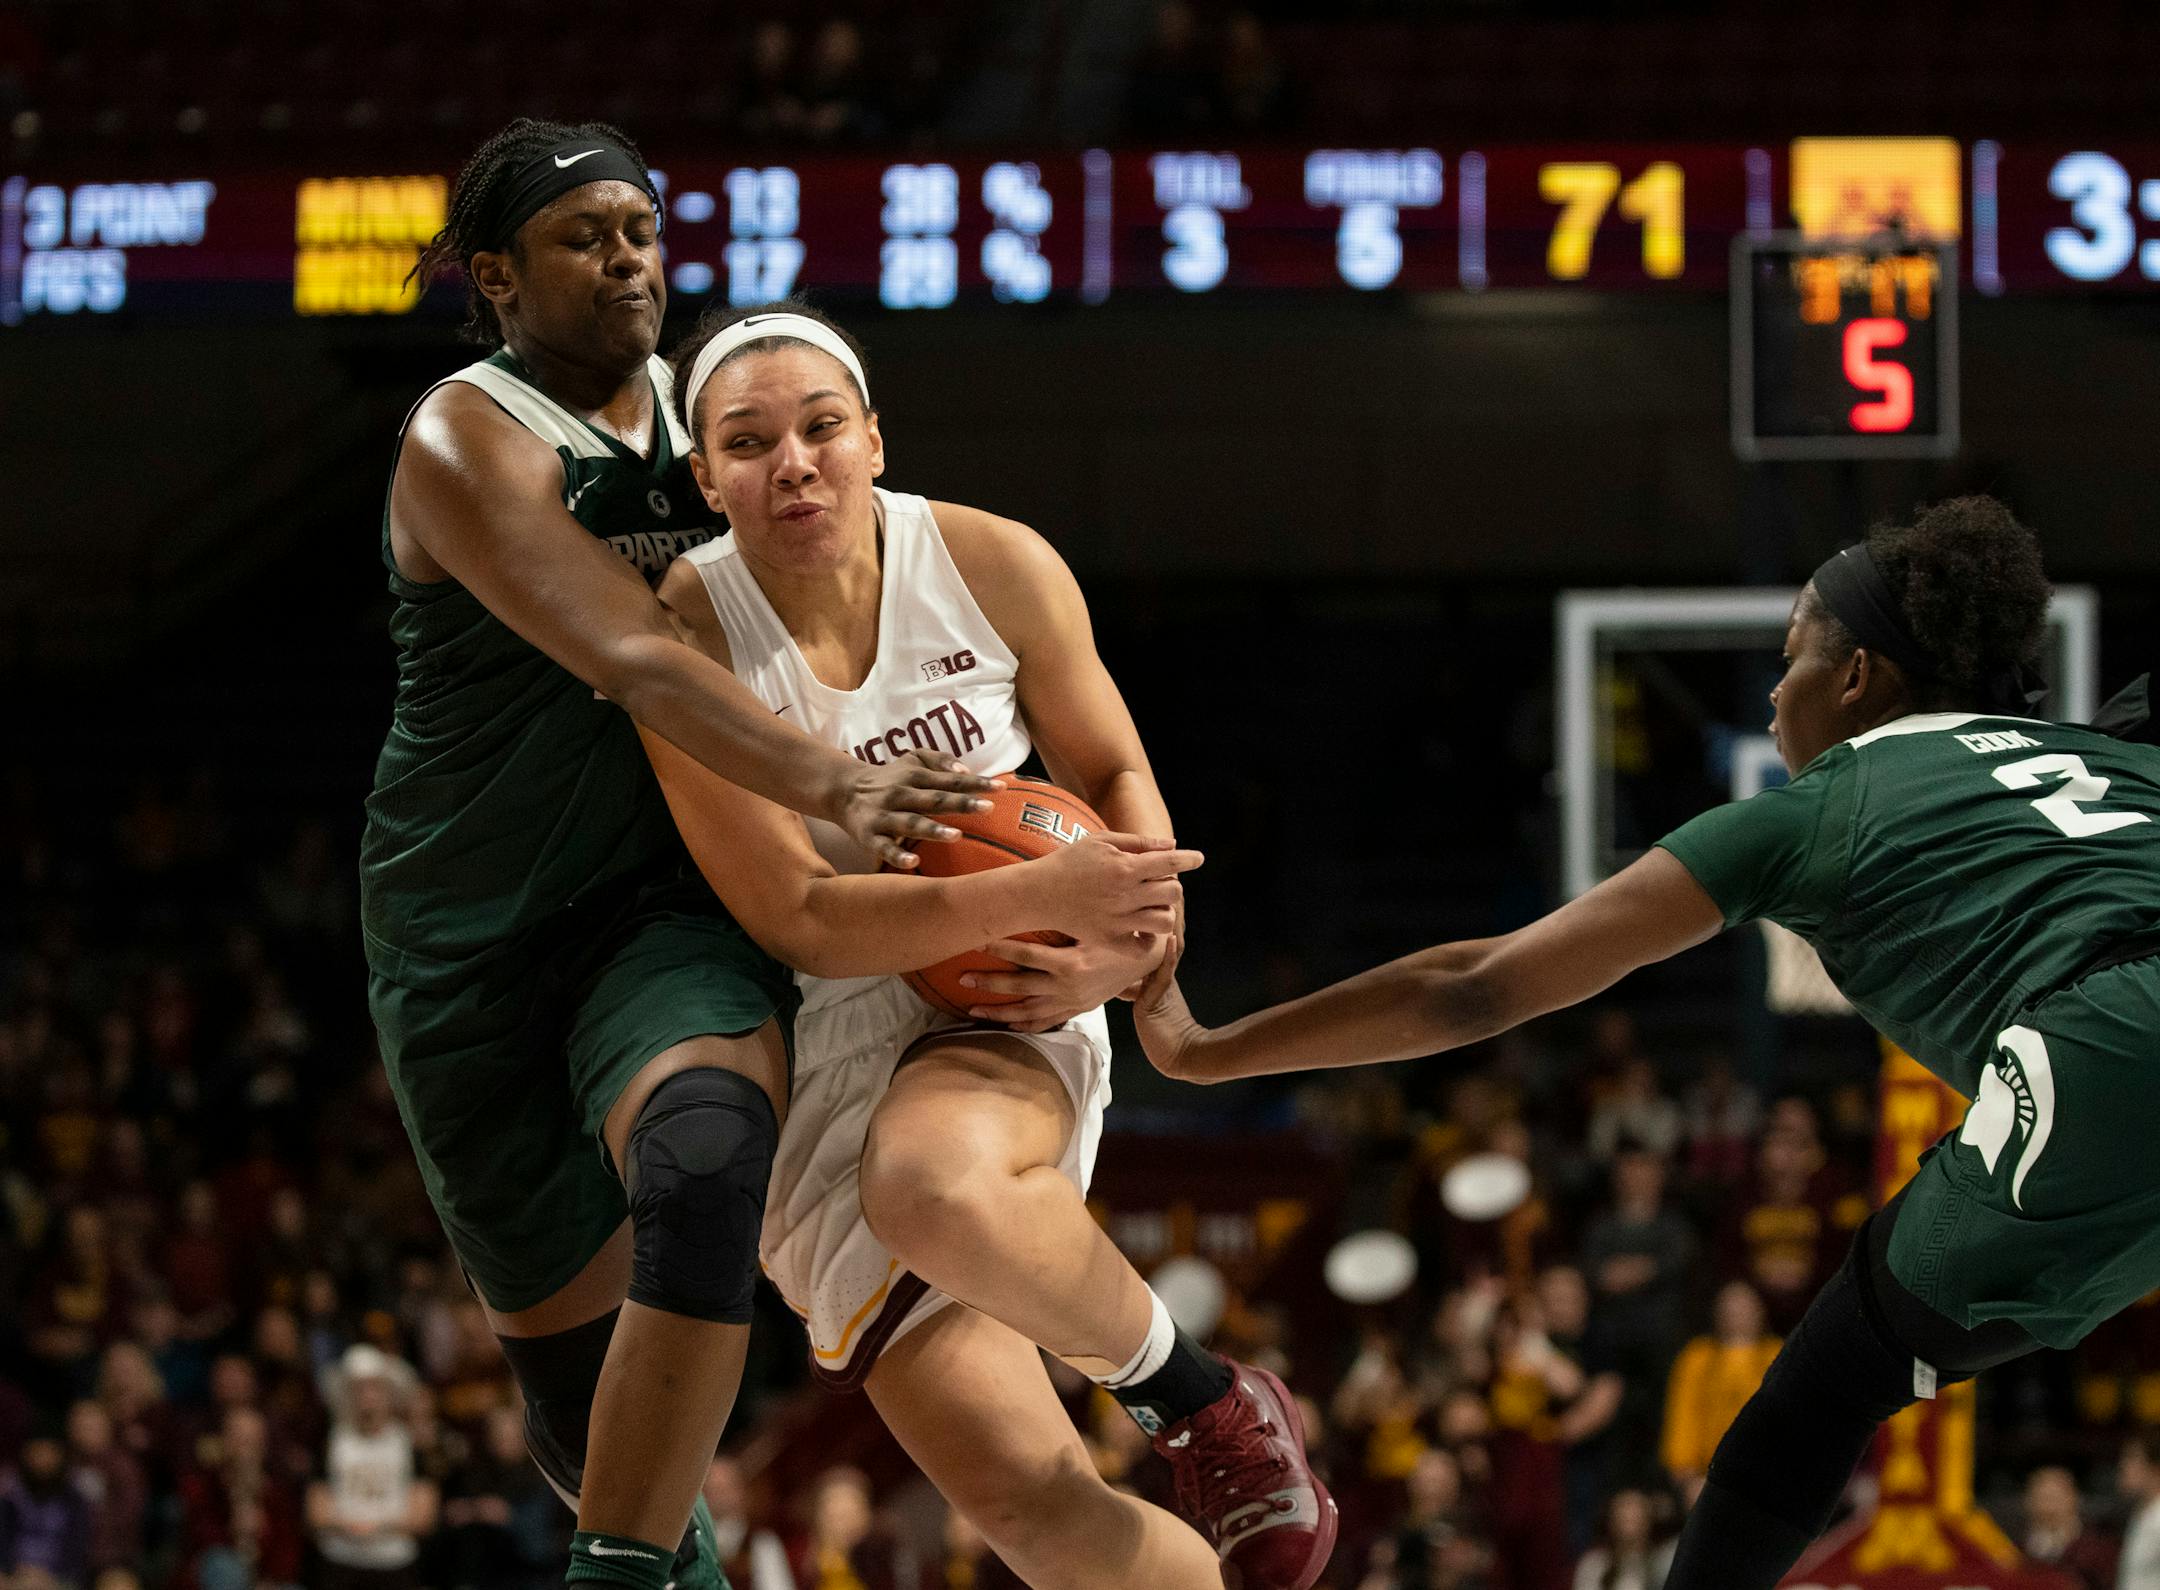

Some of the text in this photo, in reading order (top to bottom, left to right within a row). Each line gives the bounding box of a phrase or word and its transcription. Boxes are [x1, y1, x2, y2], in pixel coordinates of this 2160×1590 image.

[24, 181, 216, 248] 3 POINT
[1161, 203, 1229, 292] 3
[1538, 161, 1685, 279] 71
[723, 237, 806, 308] 17
[1842, 318, 1914, 433] 5
[1953, 729, 2044, 754] COOK
[1991, 753, 2152, 838] 2
